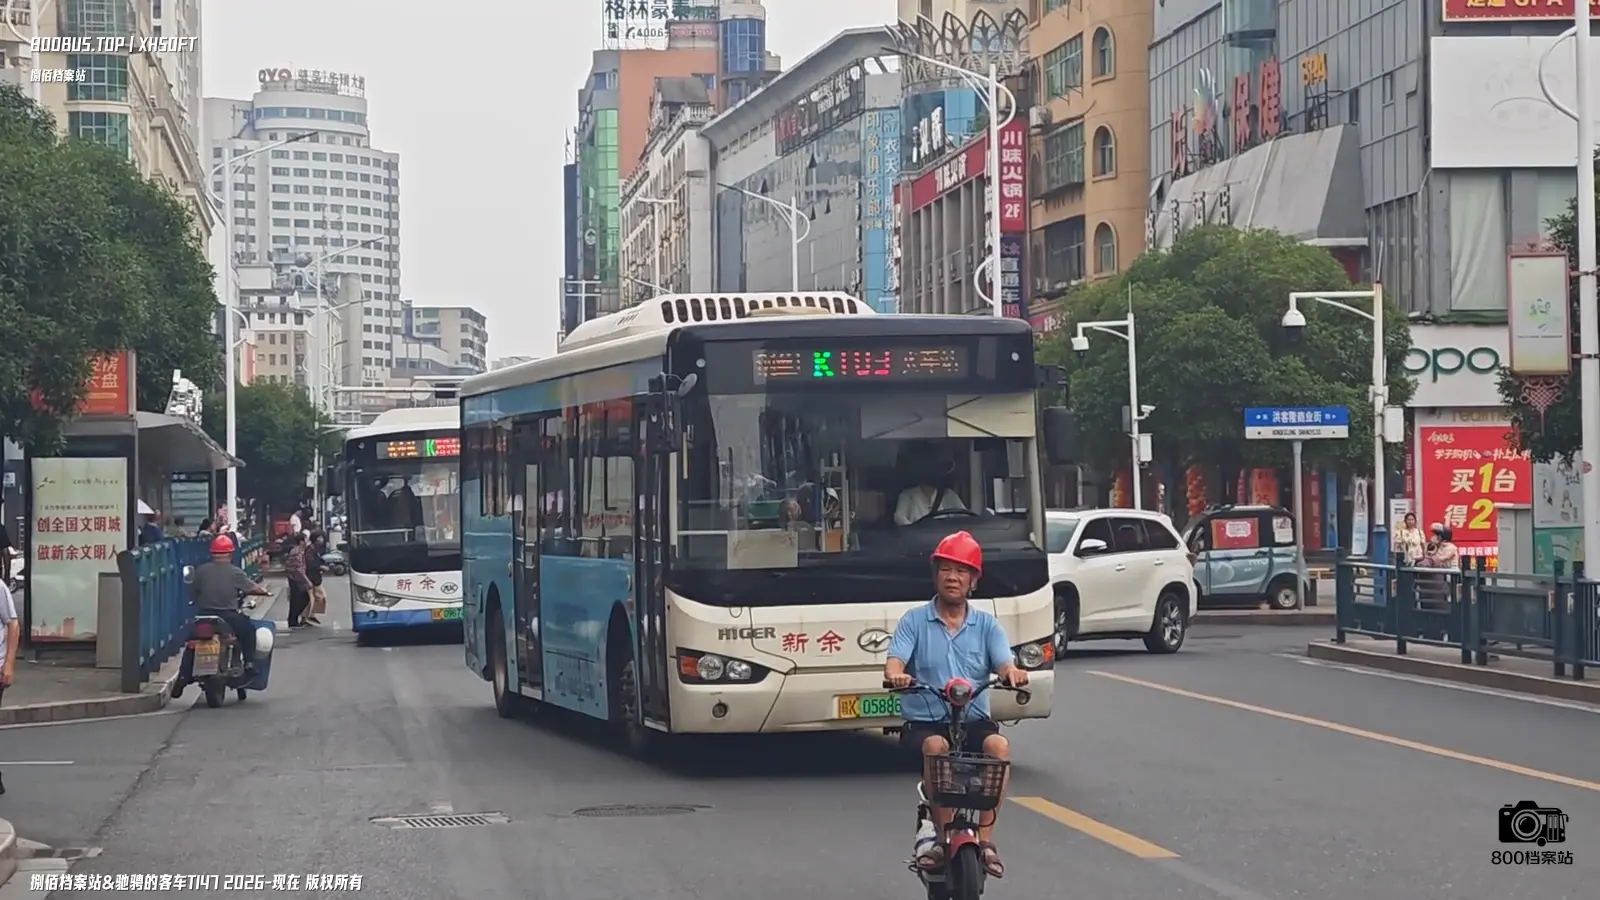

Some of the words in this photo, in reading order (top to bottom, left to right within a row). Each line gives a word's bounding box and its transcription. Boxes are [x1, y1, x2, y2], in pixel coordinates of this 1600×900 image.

[1001, 130, 1023, 199] 川味火锅
[1003, 202, 1021, 219] 2F
[1450, 462, 1517, 494] 买1台
[1443, 498, 1498, 530] 得2
[37, 516, 121, 533] 创全国文明城
[37, 544, 119, 561] 做新余文明人
[396, 576, 437, 591] 新余
[717, 626, 777, 641] HIGER
[781, 630, 846, 654] 新余
